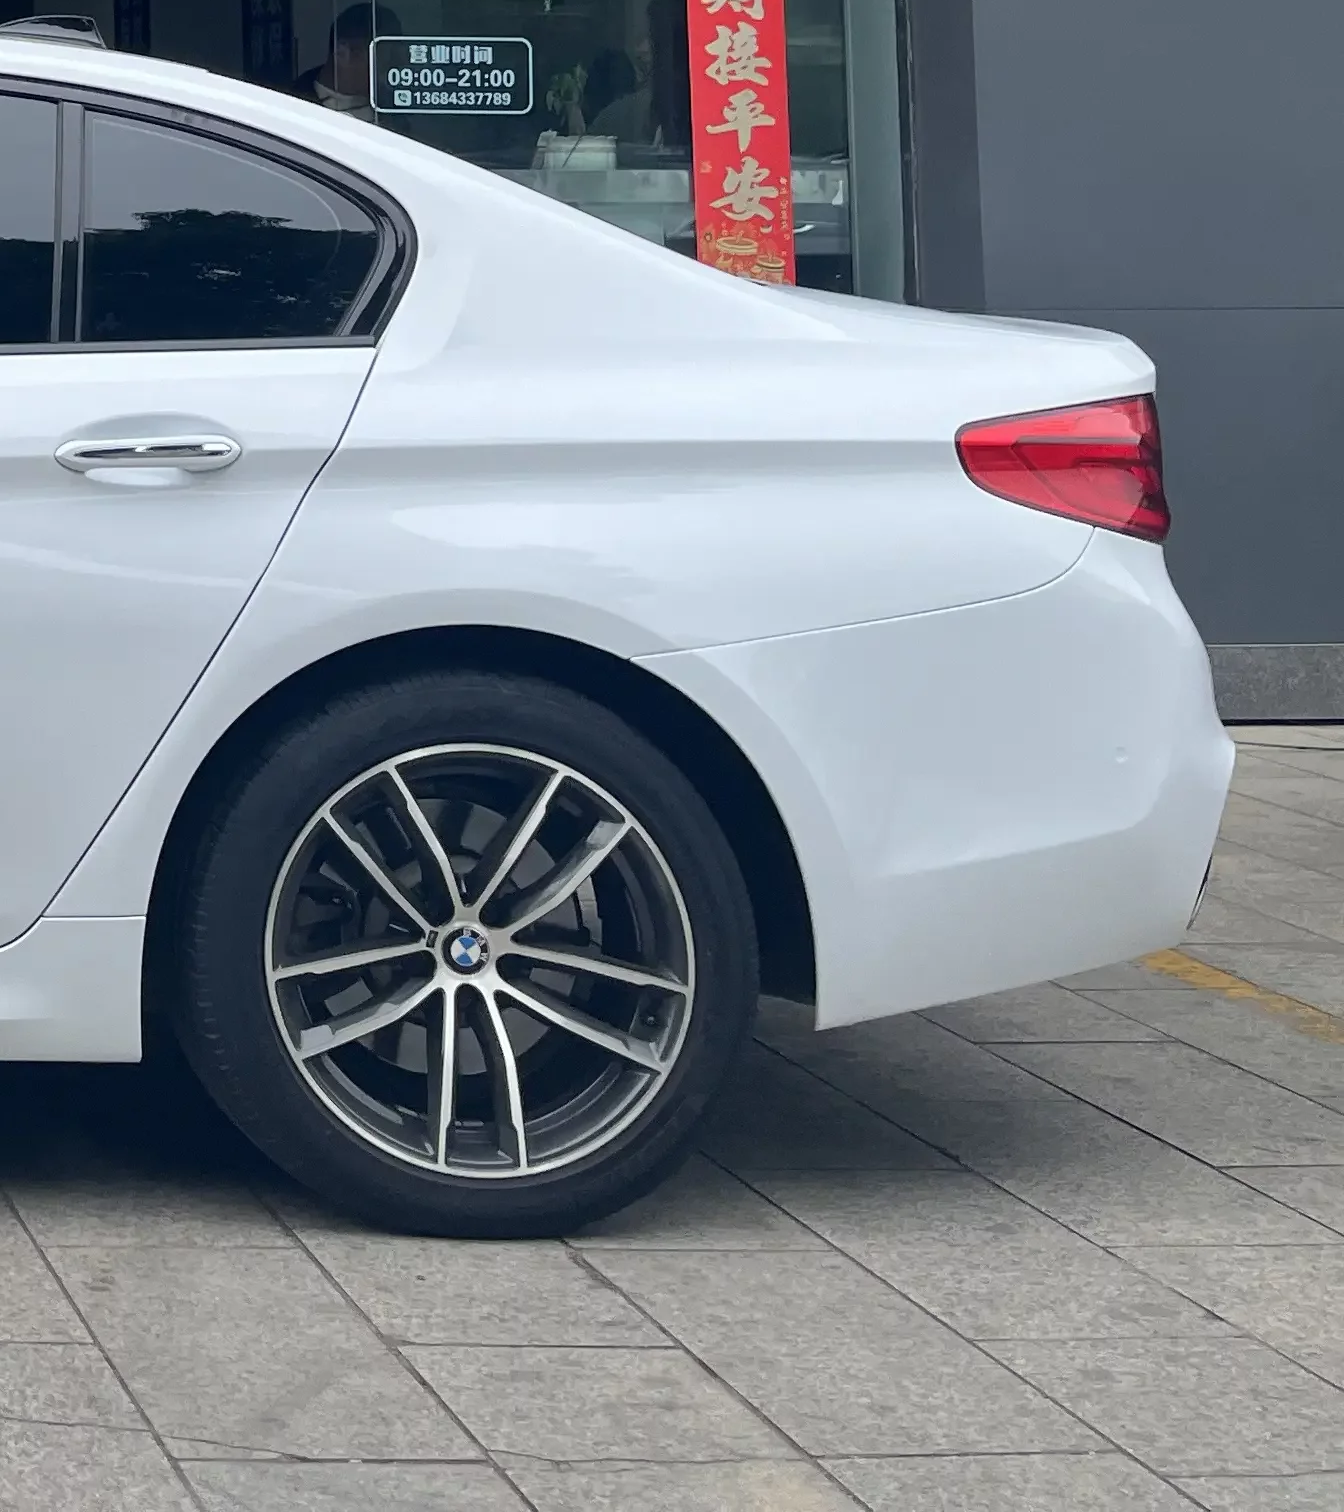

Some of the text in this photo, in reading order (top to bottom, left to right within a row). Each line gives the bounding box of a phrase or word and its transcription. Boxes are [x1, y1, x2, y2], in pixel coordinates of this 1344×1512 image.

[409, 44, 493, 65] 营业时间
[413, 91, 512, 106] 13684337789
